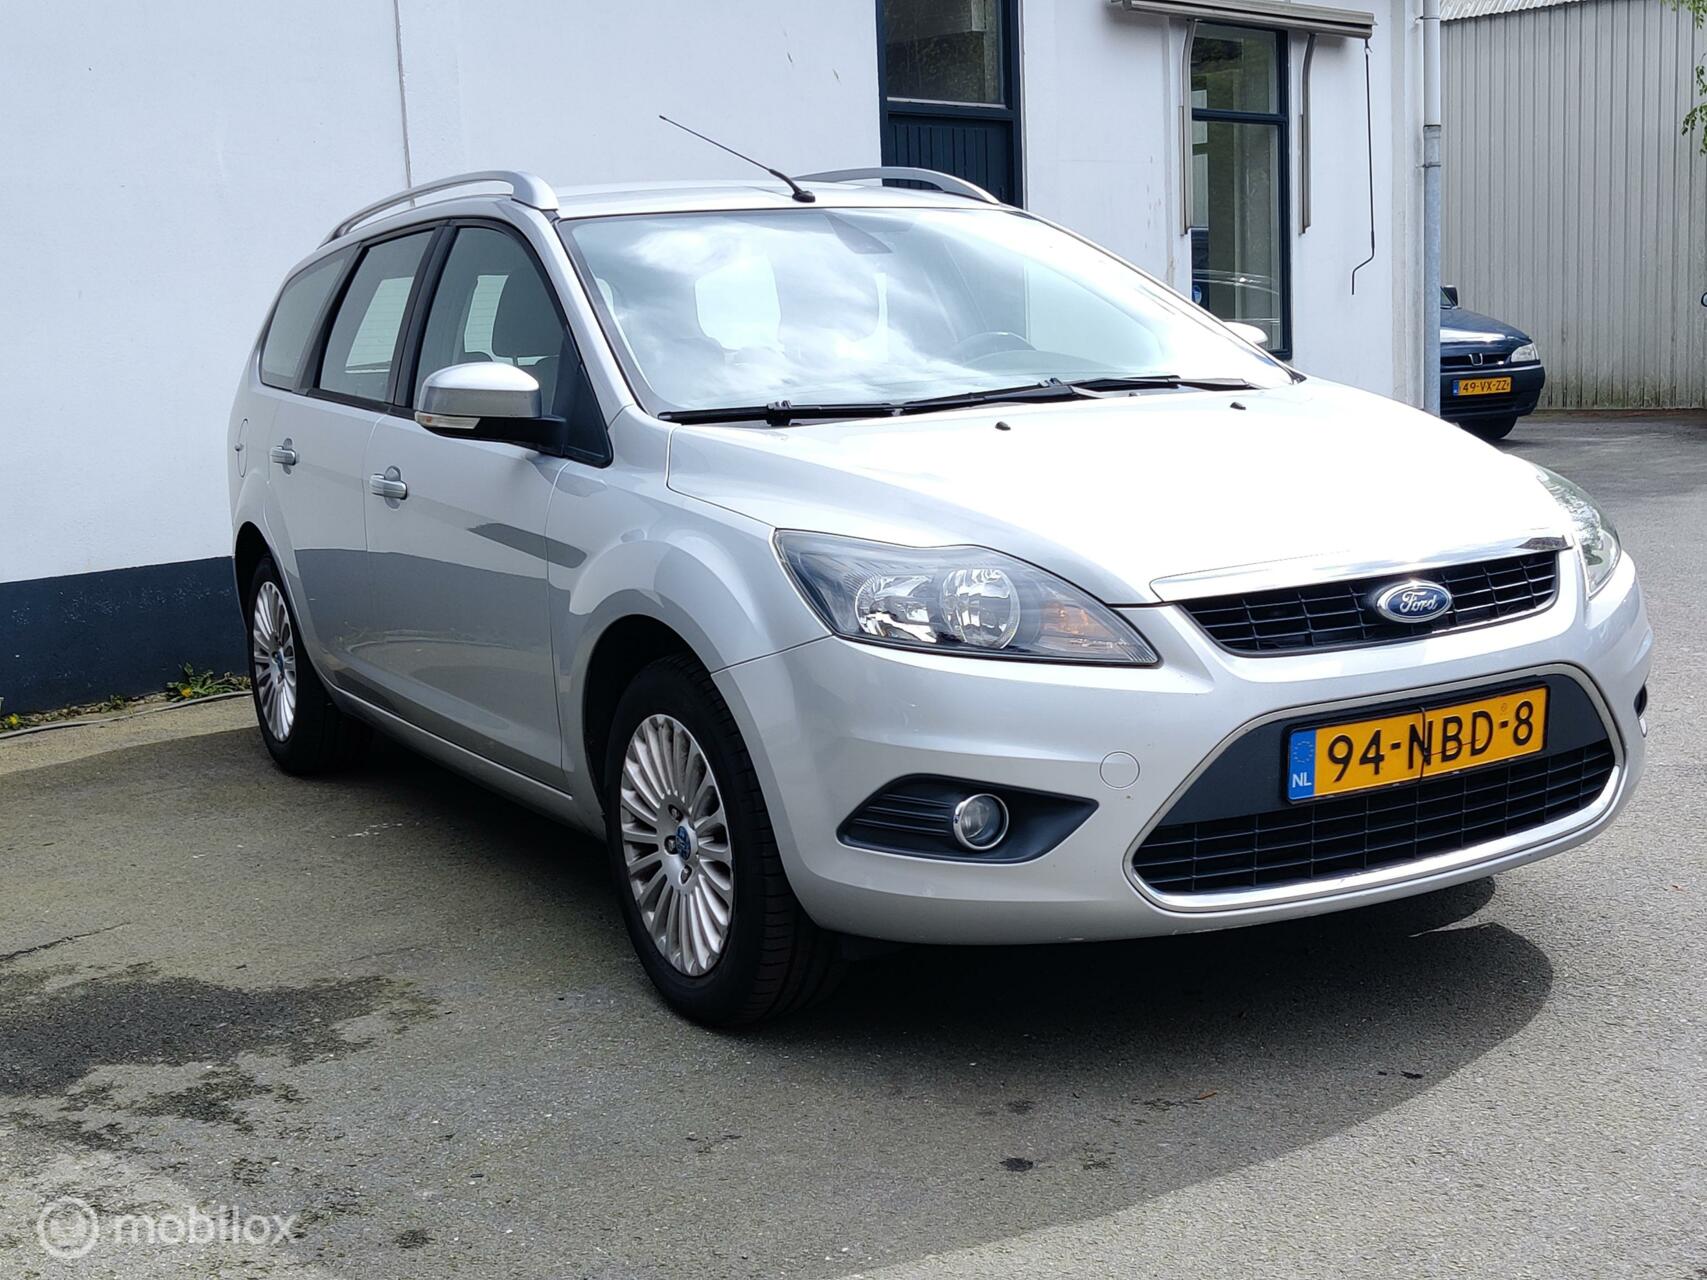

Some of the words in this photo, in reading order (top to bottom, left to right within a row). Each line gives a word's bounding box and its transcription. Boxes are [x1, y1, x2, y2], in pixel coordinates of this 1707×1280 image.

[1462, 380, 1507, 392] 49-VX-ZZ
[1400, 591, 1438, 613] Ford
[1327, 700, 1534, 783] 94-NBD-8
[1291, 772, 1312, 789] NL
